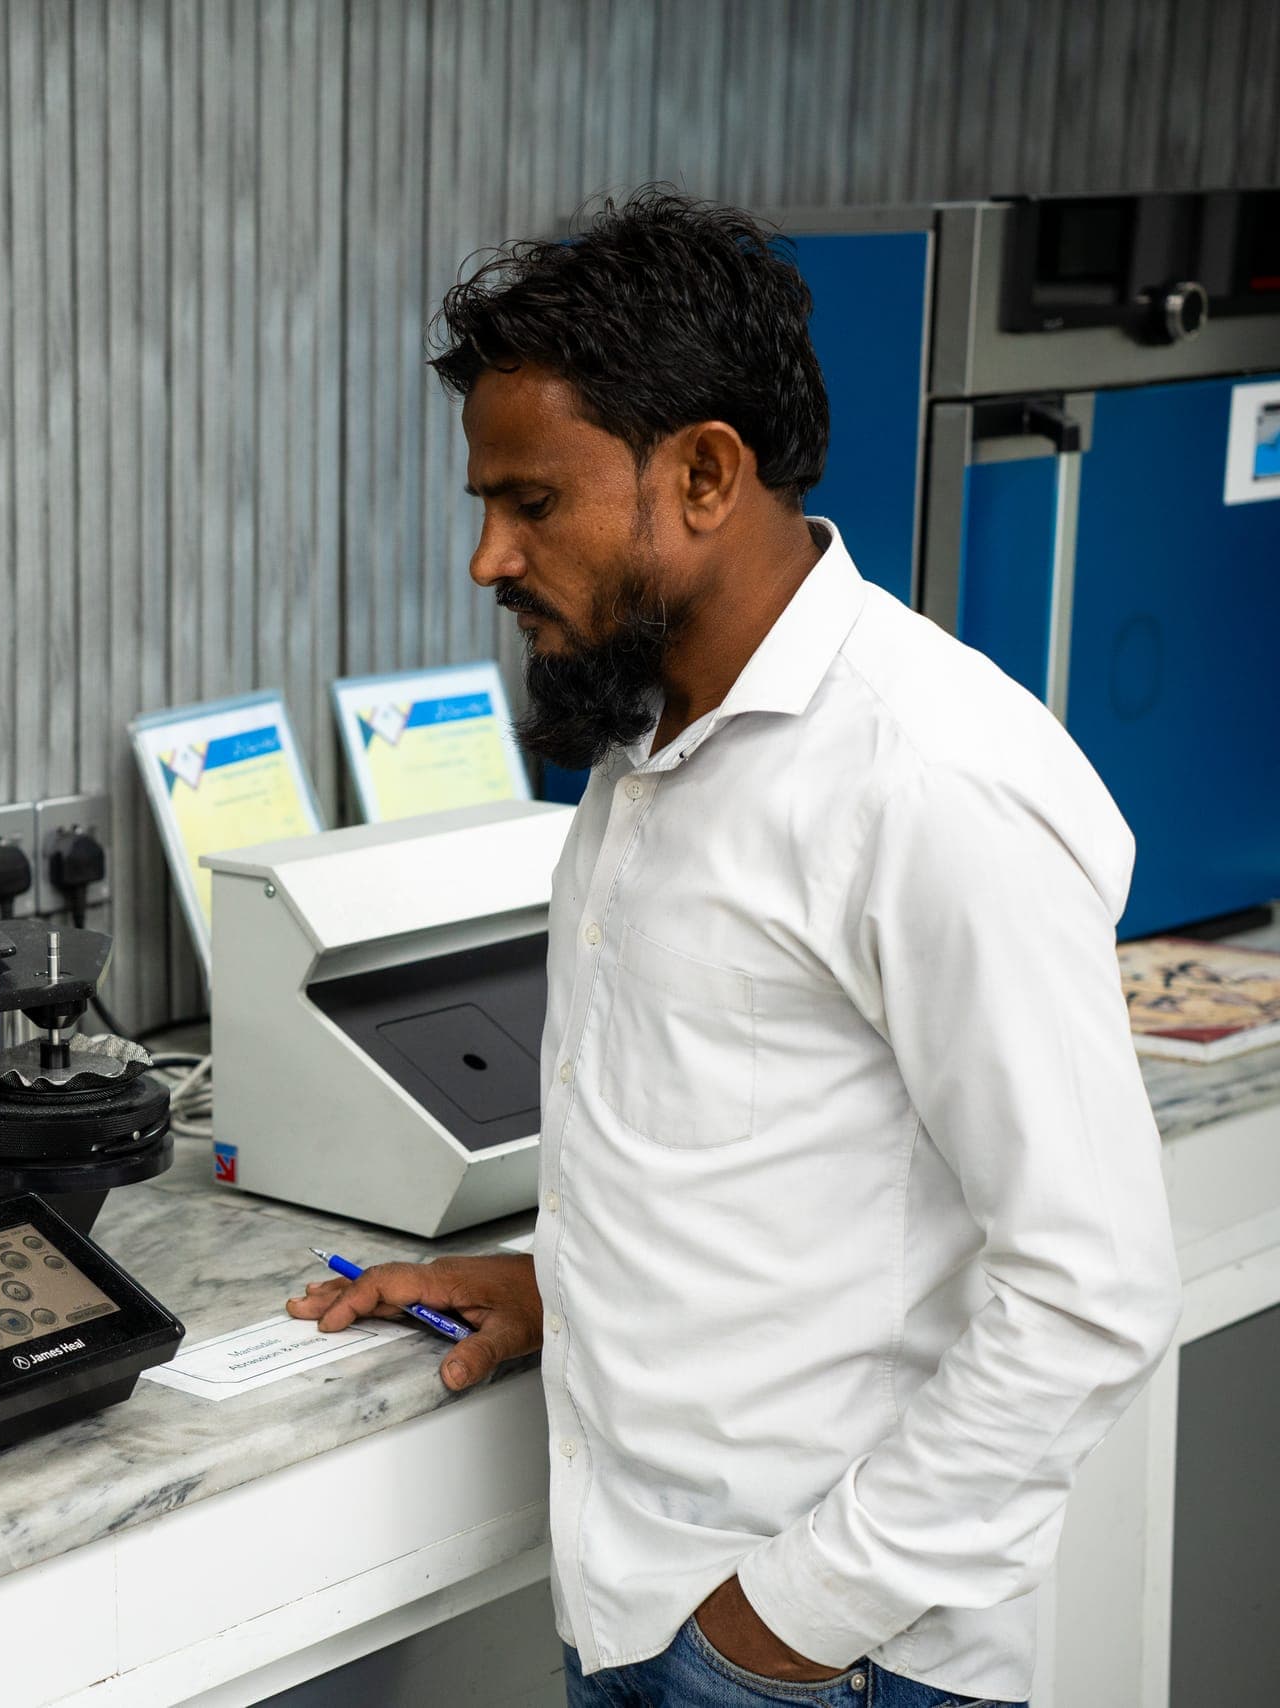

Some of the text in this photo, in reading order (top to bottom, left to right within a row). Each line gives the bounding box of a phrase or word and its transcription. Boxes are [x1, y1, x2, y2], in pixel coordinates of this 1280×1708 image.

[420, 1309, 440, 1323] PIANO
[30, 1338, 86, 1364] James Heal
